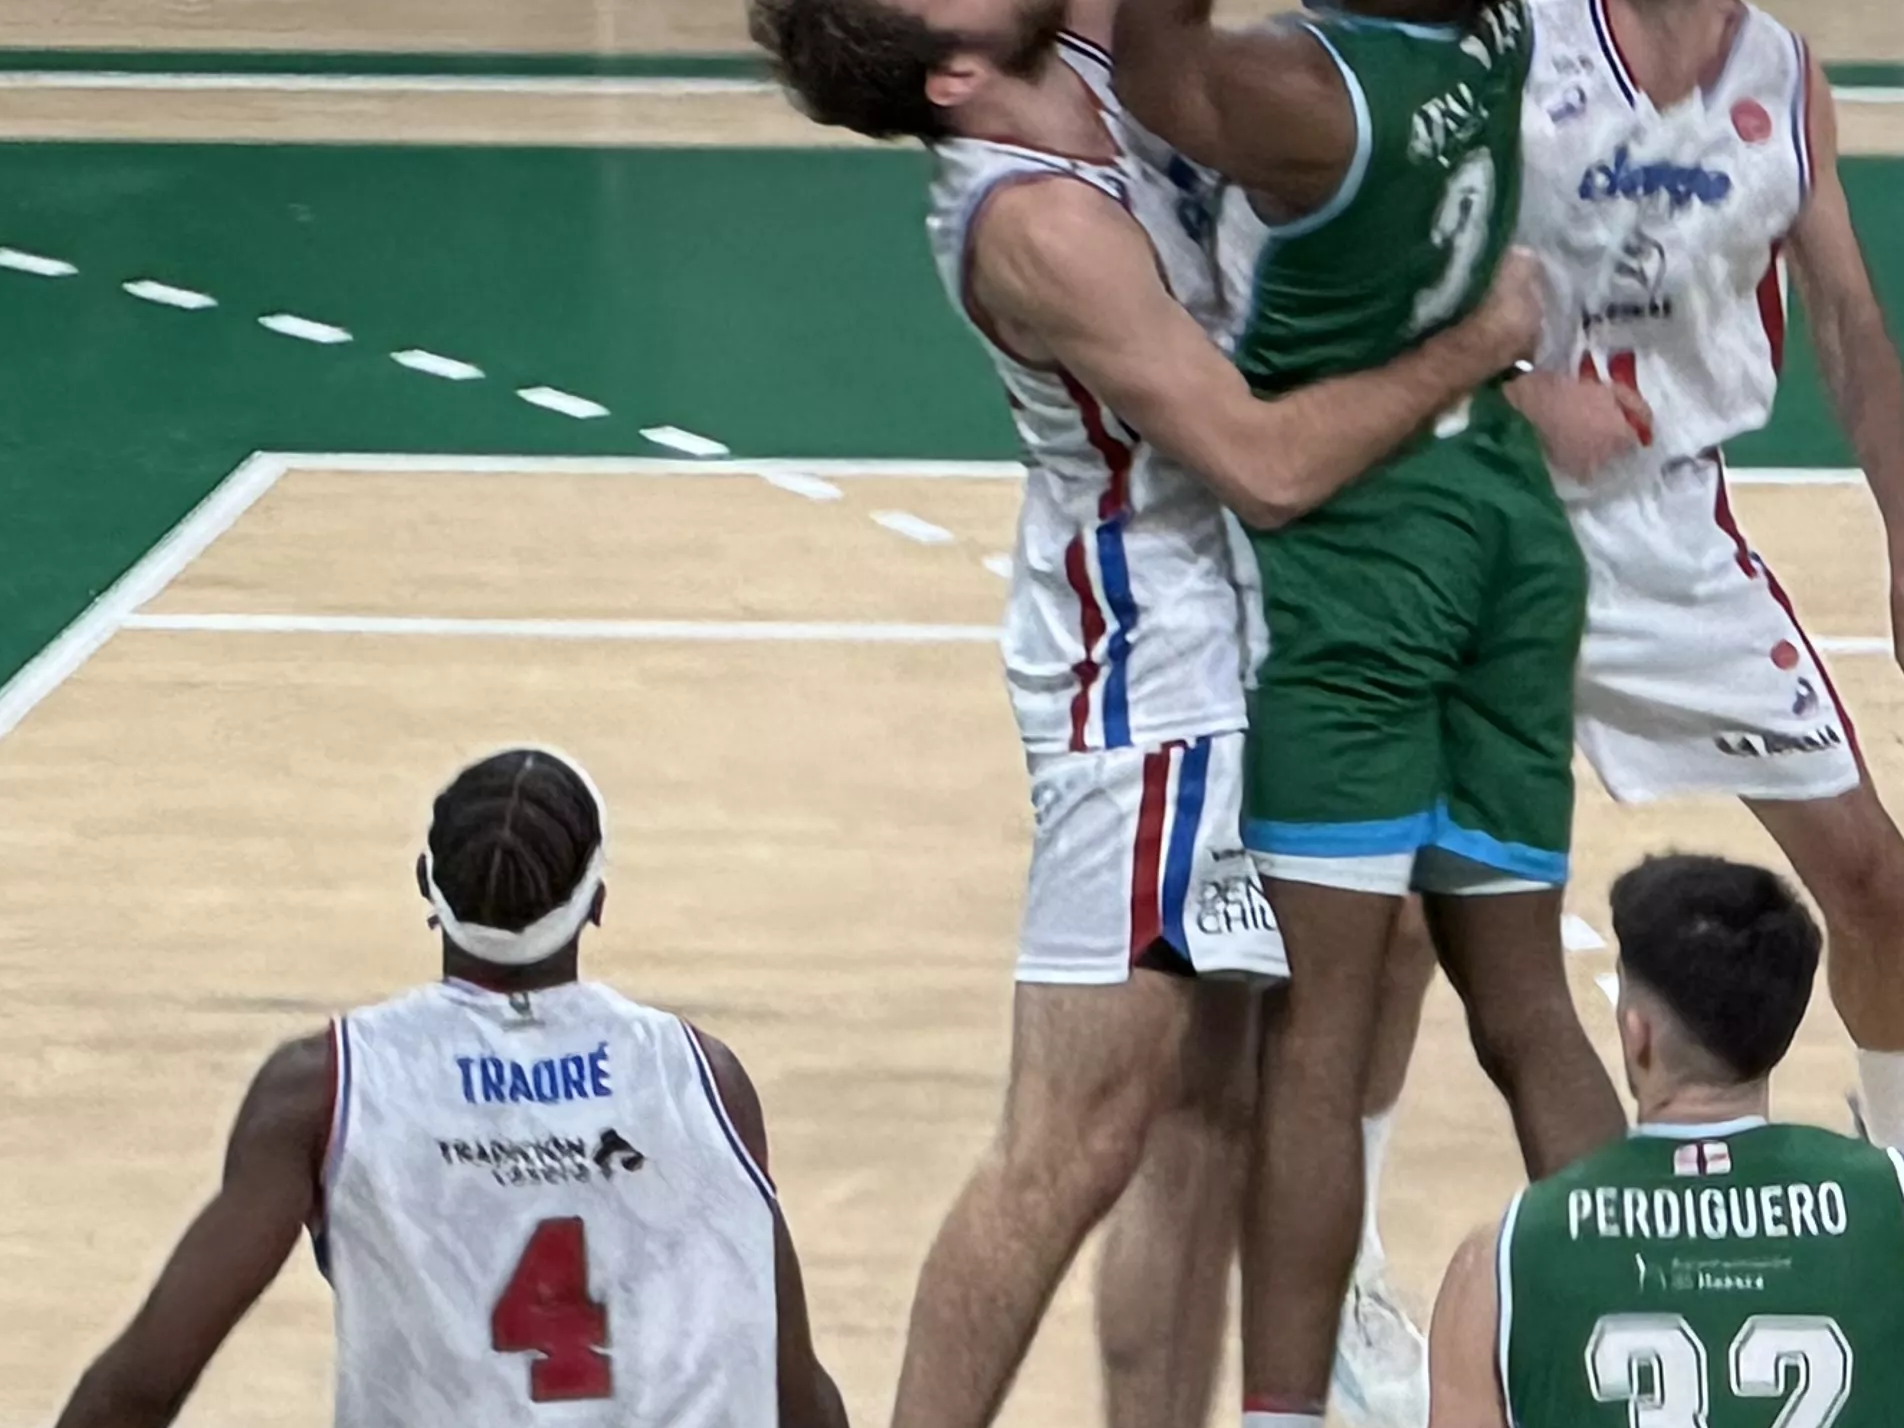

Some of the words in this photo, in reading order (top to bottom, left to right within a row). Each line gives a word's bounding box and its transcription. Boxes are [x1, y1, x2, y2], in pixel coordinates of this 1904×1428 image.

[455, 1040, 613, 1105] TRAORÉ
[1567, 1181, 1848, 1241] PERDIGUERO
[491, 1215, 613, 1402] 4
